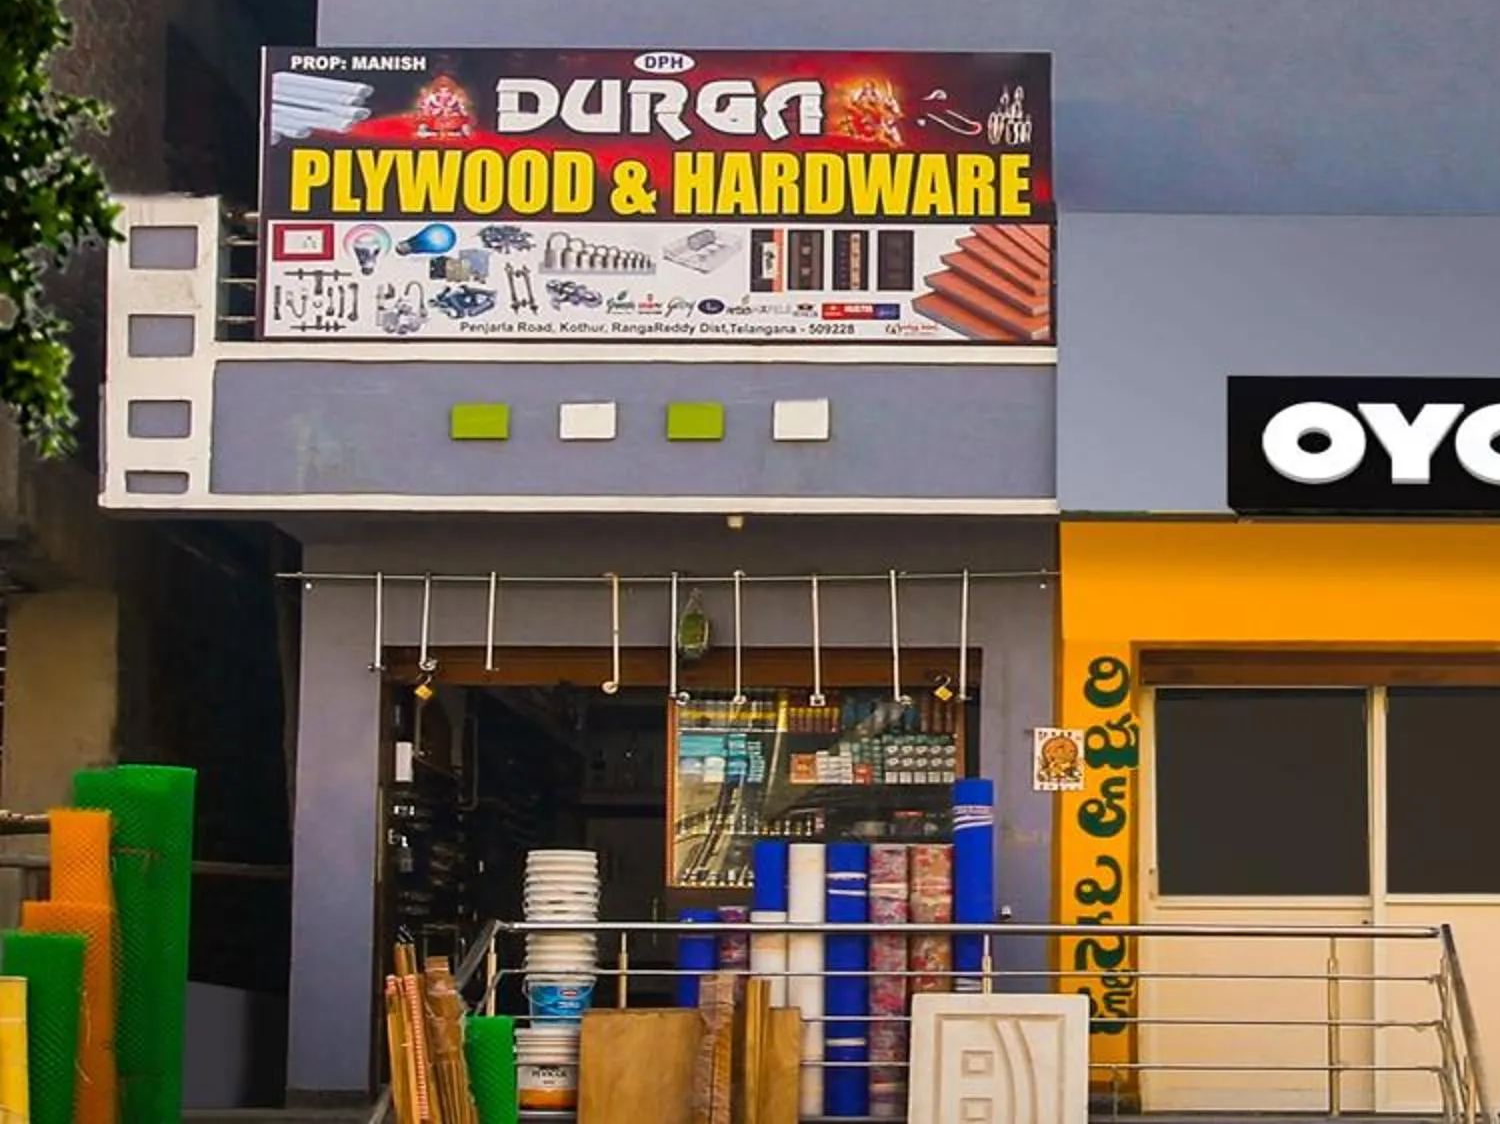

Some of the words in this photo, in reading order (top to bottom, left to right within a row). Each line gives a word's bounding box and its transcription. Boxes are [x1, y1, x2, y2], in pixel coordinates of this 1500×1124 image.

[290, 55, 347, 71] PROP:
[351, 56, 427, 71] MANISH
[643, 55, 685, 70] DPH
[496, 78, 823, 142] DURGA
[290, 148, 595, 214] PLYWOOD
[610, 160, 657, 215] &
[673, 151, 1031, 218] HARDWARE
[460, 322, 514, 335] Penjarla
[611, 323, 696, 335] RangaReddy
[808, 323, 855, 335] 509228
